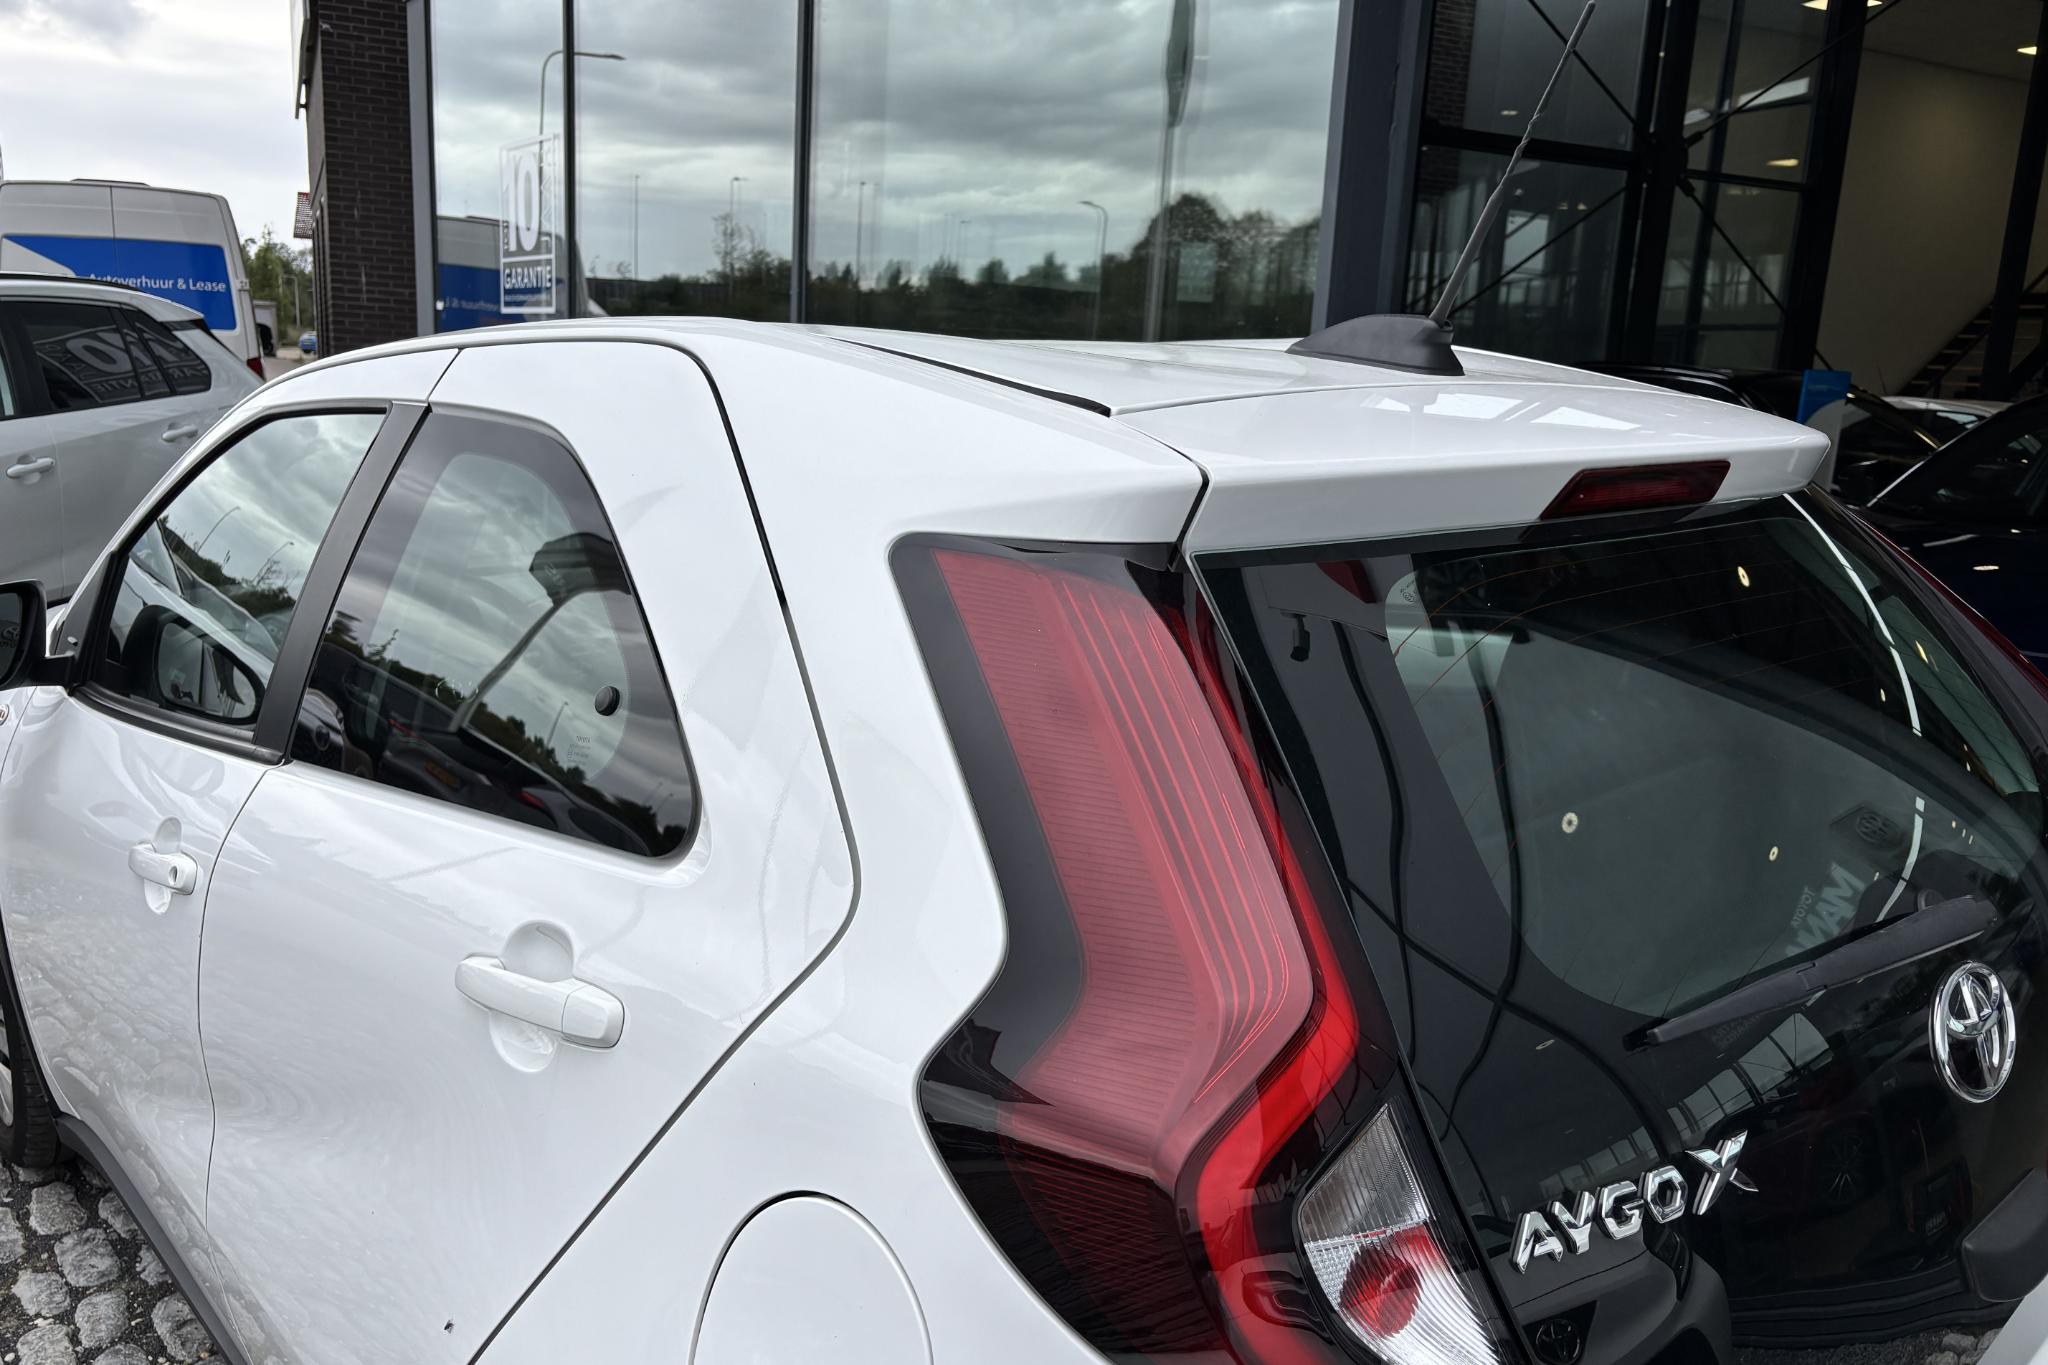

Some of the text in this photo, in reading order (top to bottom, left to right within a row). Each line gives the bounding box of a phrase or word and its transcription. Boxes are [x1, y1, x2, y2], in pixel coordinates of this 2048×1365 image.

[503, 152, 539, 251] 10
[176, 278, 186, 289] &
[189, 278, 226, 292] Lease
[504, 266, 551, 289] GARANTIE
[1501, 1129, 1759, 1274] AYGO X
